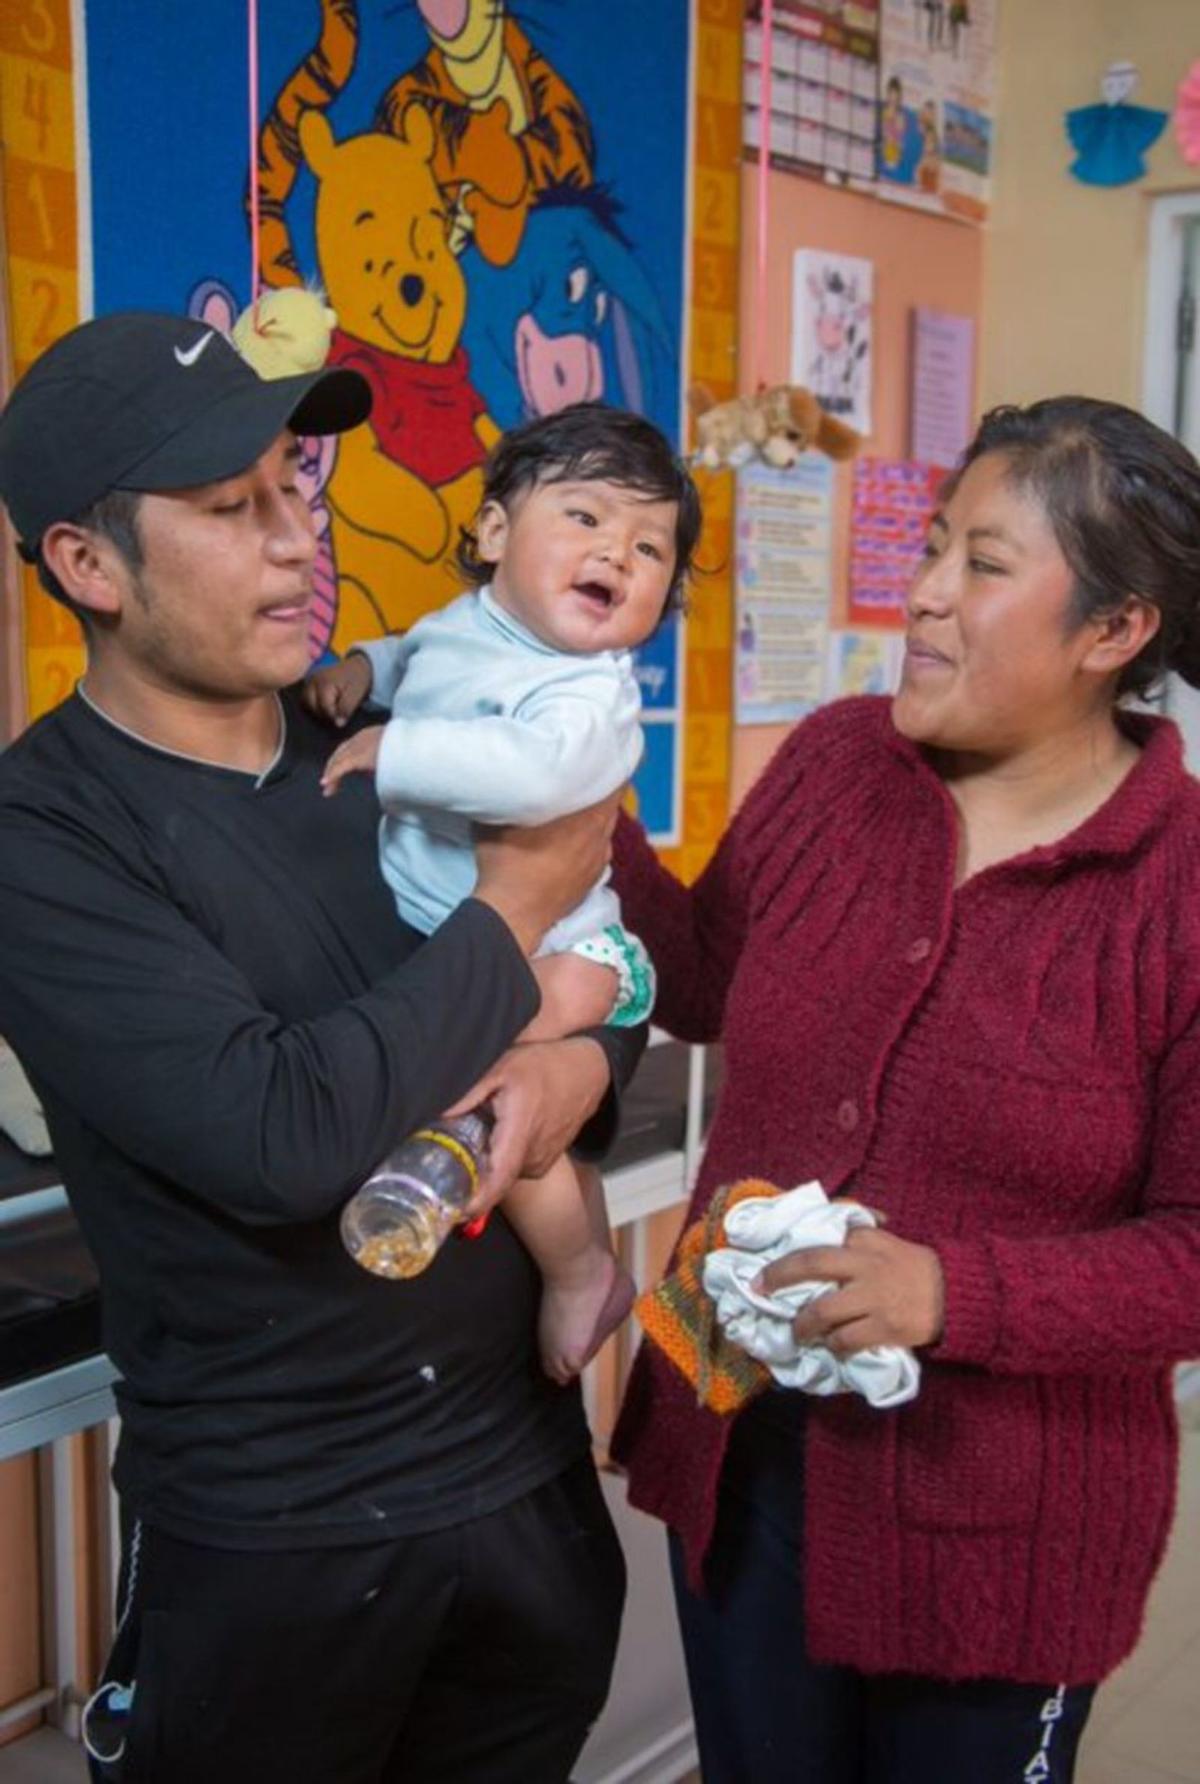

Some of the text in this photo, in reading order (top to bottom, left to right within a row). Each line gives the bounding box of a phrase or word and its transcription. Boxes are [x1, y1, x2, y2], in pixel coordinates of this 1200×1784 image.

[23, 71, 51, 152] 4
[27, 170, 54, 251] 1
[702, 177, 722, 230] 2
